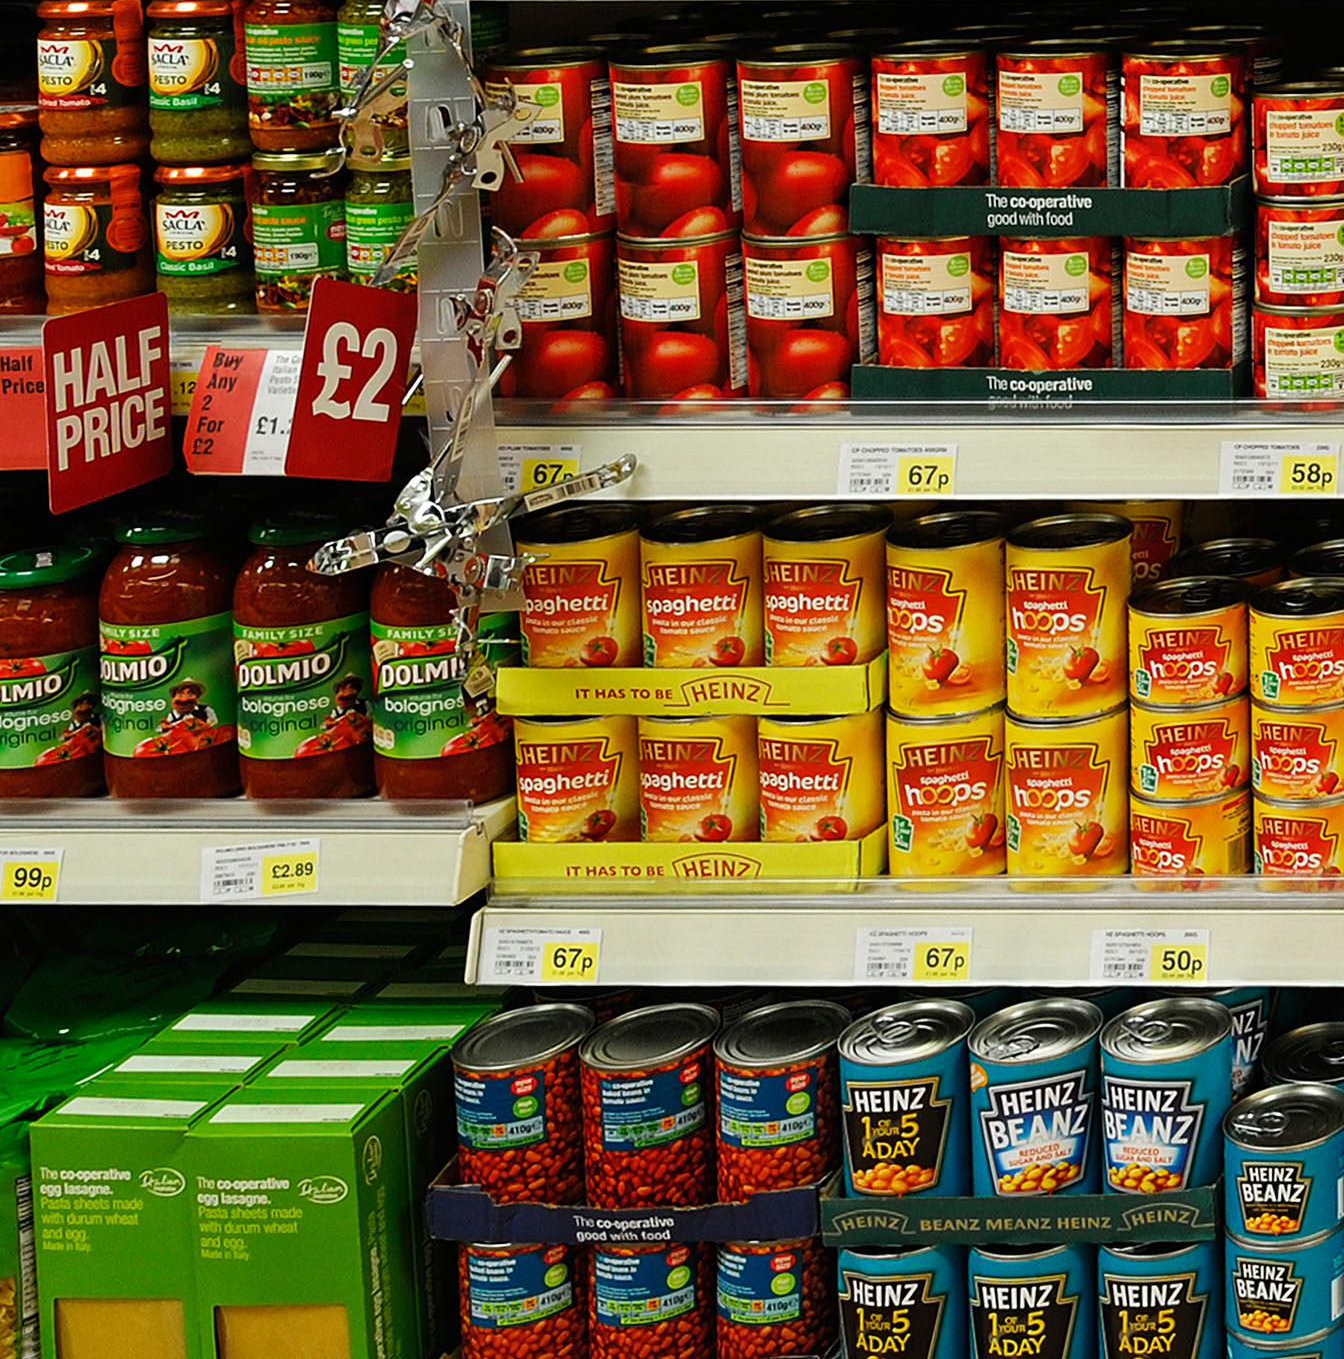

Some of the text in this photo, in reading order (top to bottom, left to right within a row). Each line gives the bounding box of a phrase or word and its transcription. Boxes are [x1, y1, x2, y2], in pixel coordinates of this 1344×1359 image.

[986, 192, 1092, 213] The co-operative
[987, 210, 1074, 229] good with food
[166, 241, 203, 251] PESTO
[54, 326, 162, 413] HALF
[213, 352, 245, 371] Buy
[312, 321, 396, 423] £2
[206, 373, 238, 393] Any
[202, 395, 213, 410] 2
[58, 386, 165, 471] PRICE
[198, 417, 225, 434] For
[192, 439, 214, 455] £2
[646, 594, 737, 616] spaghetti
[1013, 609, 1085, 634] hoops
[238, 653, 332, 688] DOLMIO
[576, 682, 760, 703] IT HAS TO BE HEINZ
[241, 695, 330, 715] bolognese
[13, 867, 52, 890] 99p
[552, 947, 593, 973] 67p
[41, 1168, 131, 1181] The co-operative
[40, 1183, 113, 1198] egg lasagne.
[41, 1197, 144, 1210] Pasta sheets made
[920, 1216, 1111, 1232] BEANZ MEANZ HEINZ
